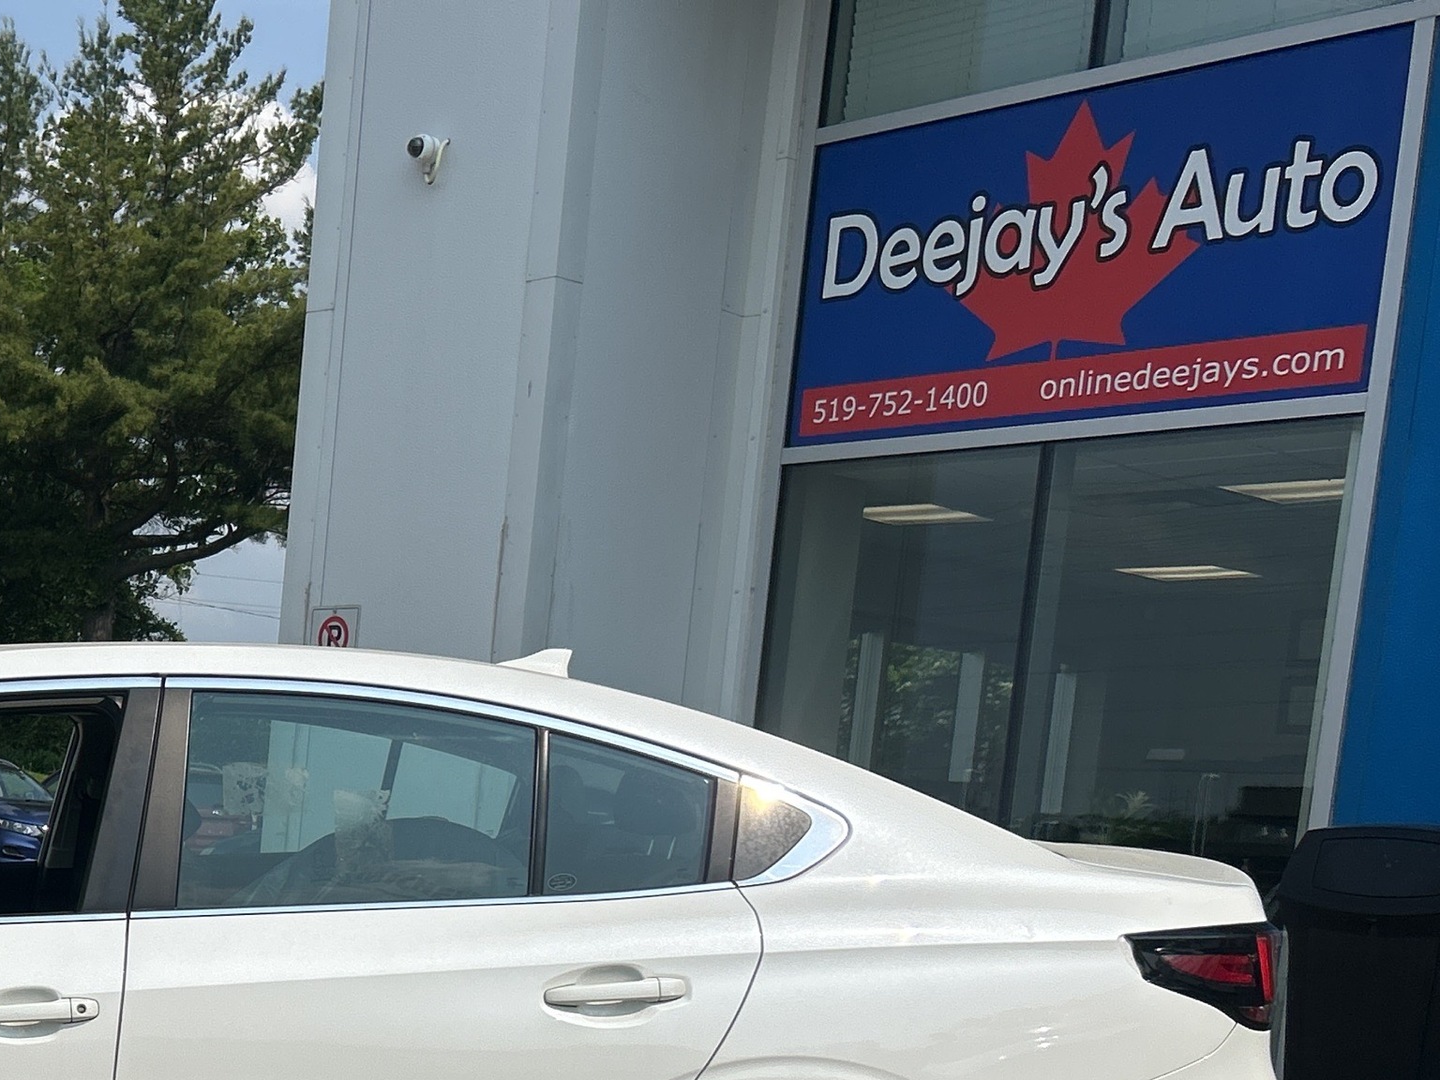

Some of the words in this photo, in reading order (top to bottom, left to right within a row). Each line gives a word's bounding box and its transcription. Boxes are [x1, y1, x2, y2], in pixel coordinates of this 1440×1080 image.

[821, 165, 1128, 299] Deejay's
[1152, 140, 1379, 249] Auto
[812, 380, 989, 424] 519-752-1400
[1039, 348, 1346, 400] onlinedeejays.com
